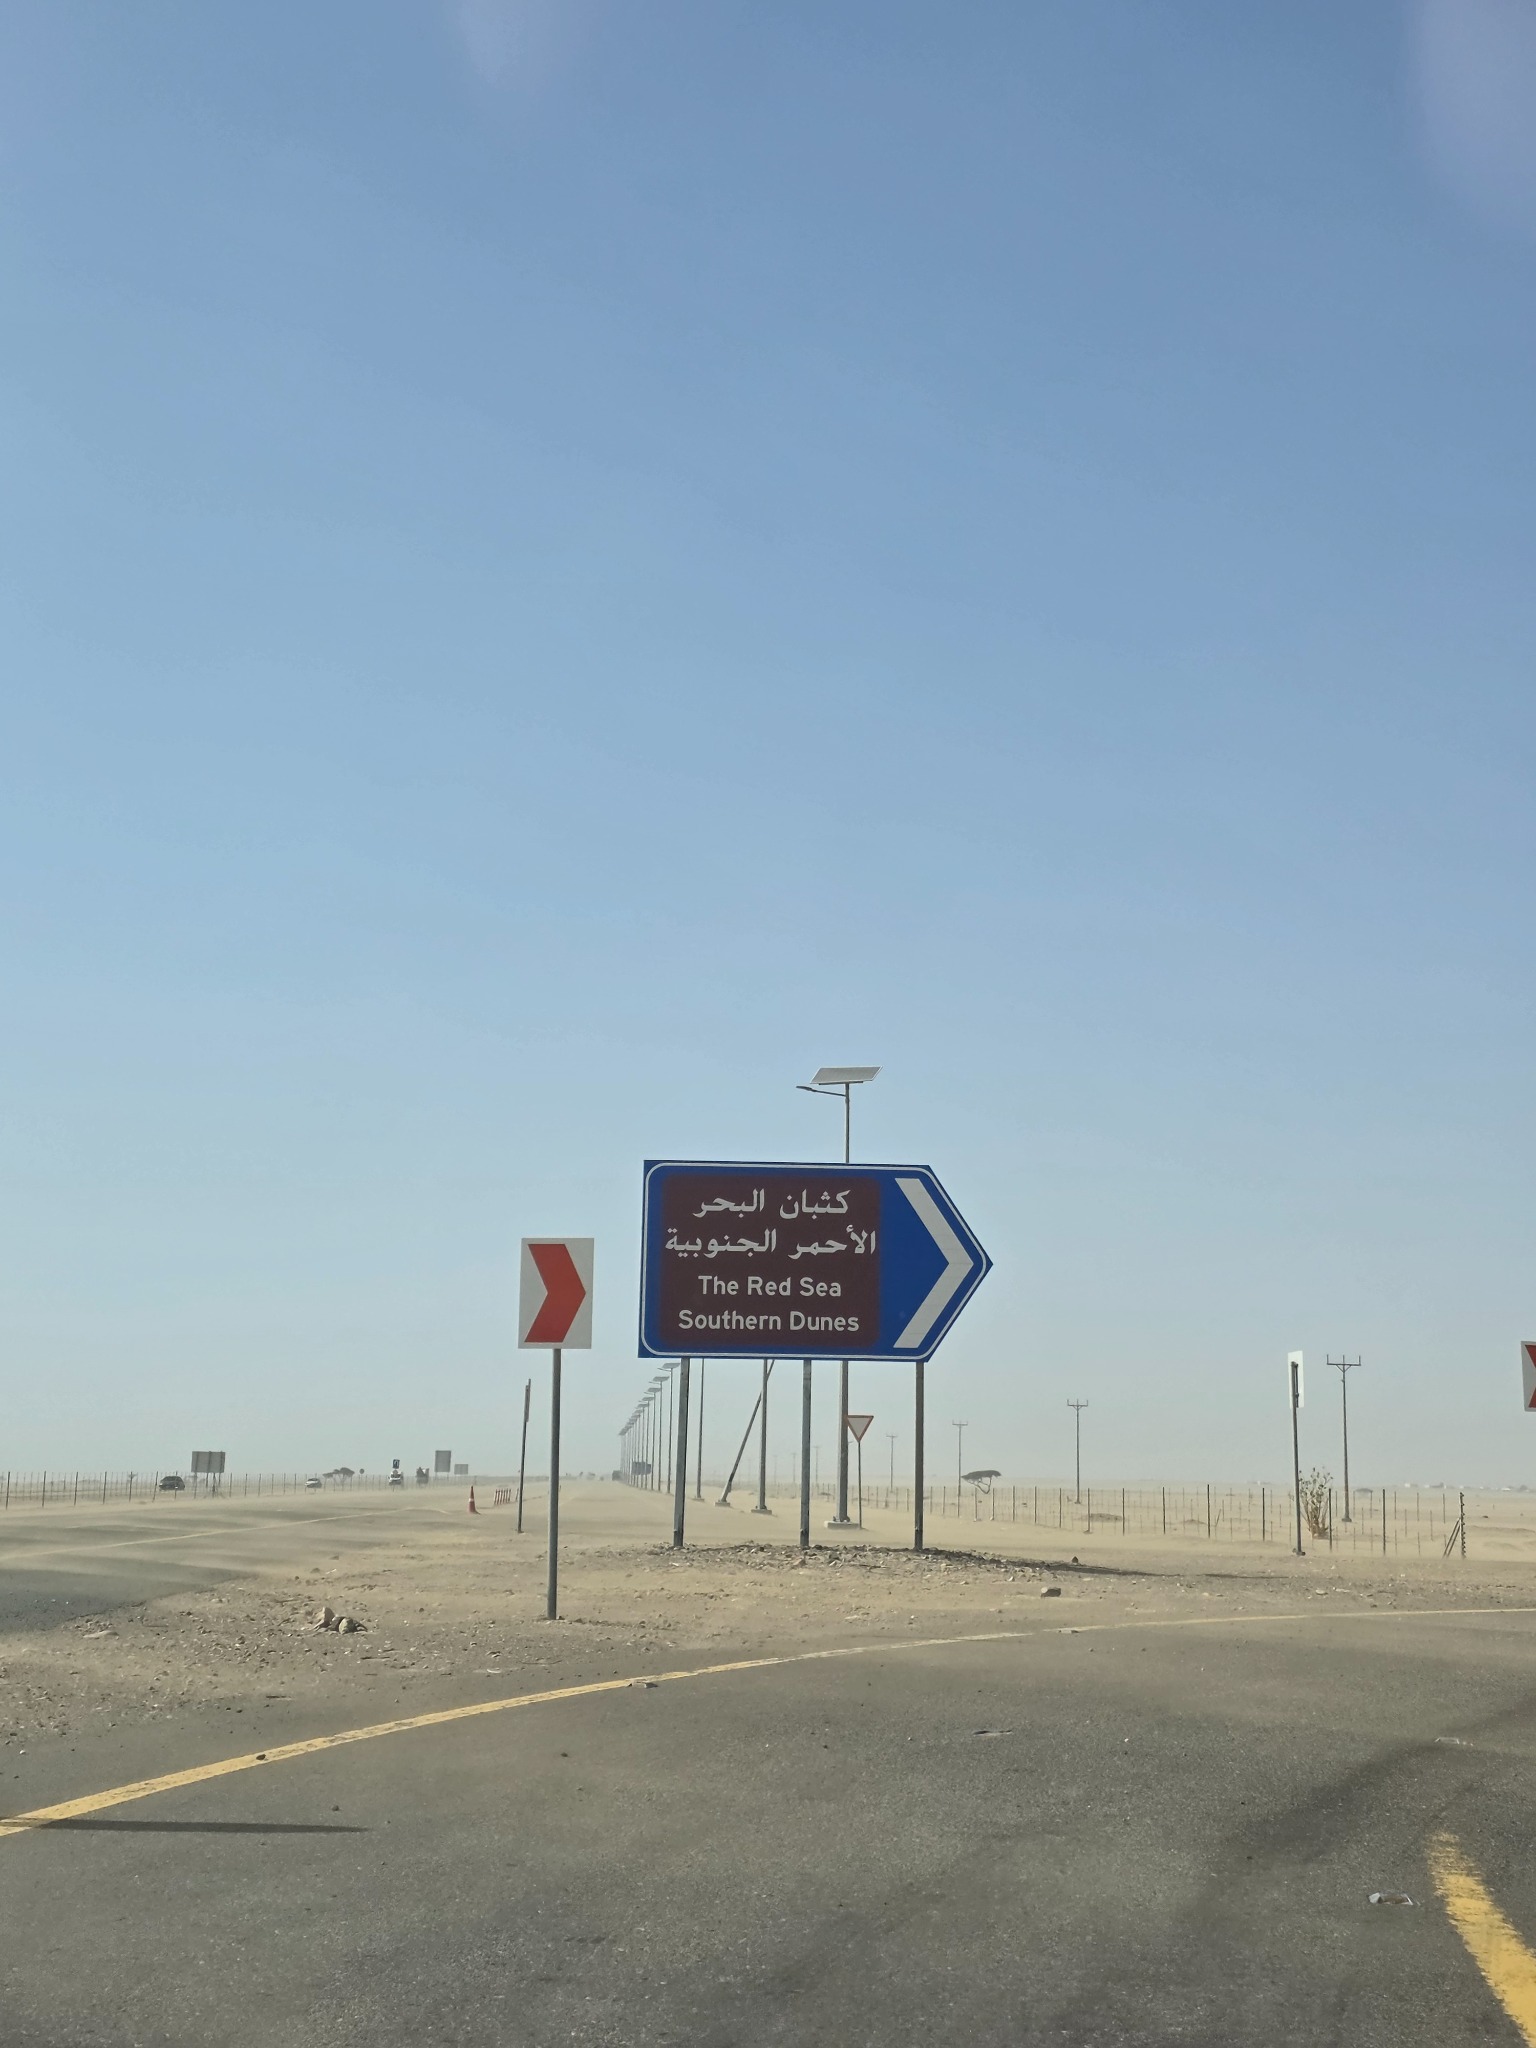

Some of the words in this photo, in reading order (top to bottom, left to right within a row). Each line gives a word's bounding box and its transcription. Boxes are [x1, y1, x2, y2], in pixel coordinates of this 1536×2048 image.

[693, 1189, 764, 1218] البحر
[780, 1189, 850, 1219] كثبان
[665, 1228, 776, 1258] الجنوبية
[788, 1225, 875, 1259] الأحمر
[698, 1276, 738, 1295] The
[748, 1276, 791, 1295] Red
[800, 1277, 841, 1296] Sea
[679, 1310, 781, 1330] Southern
[790, 1311, 859, 1331] Dunes
